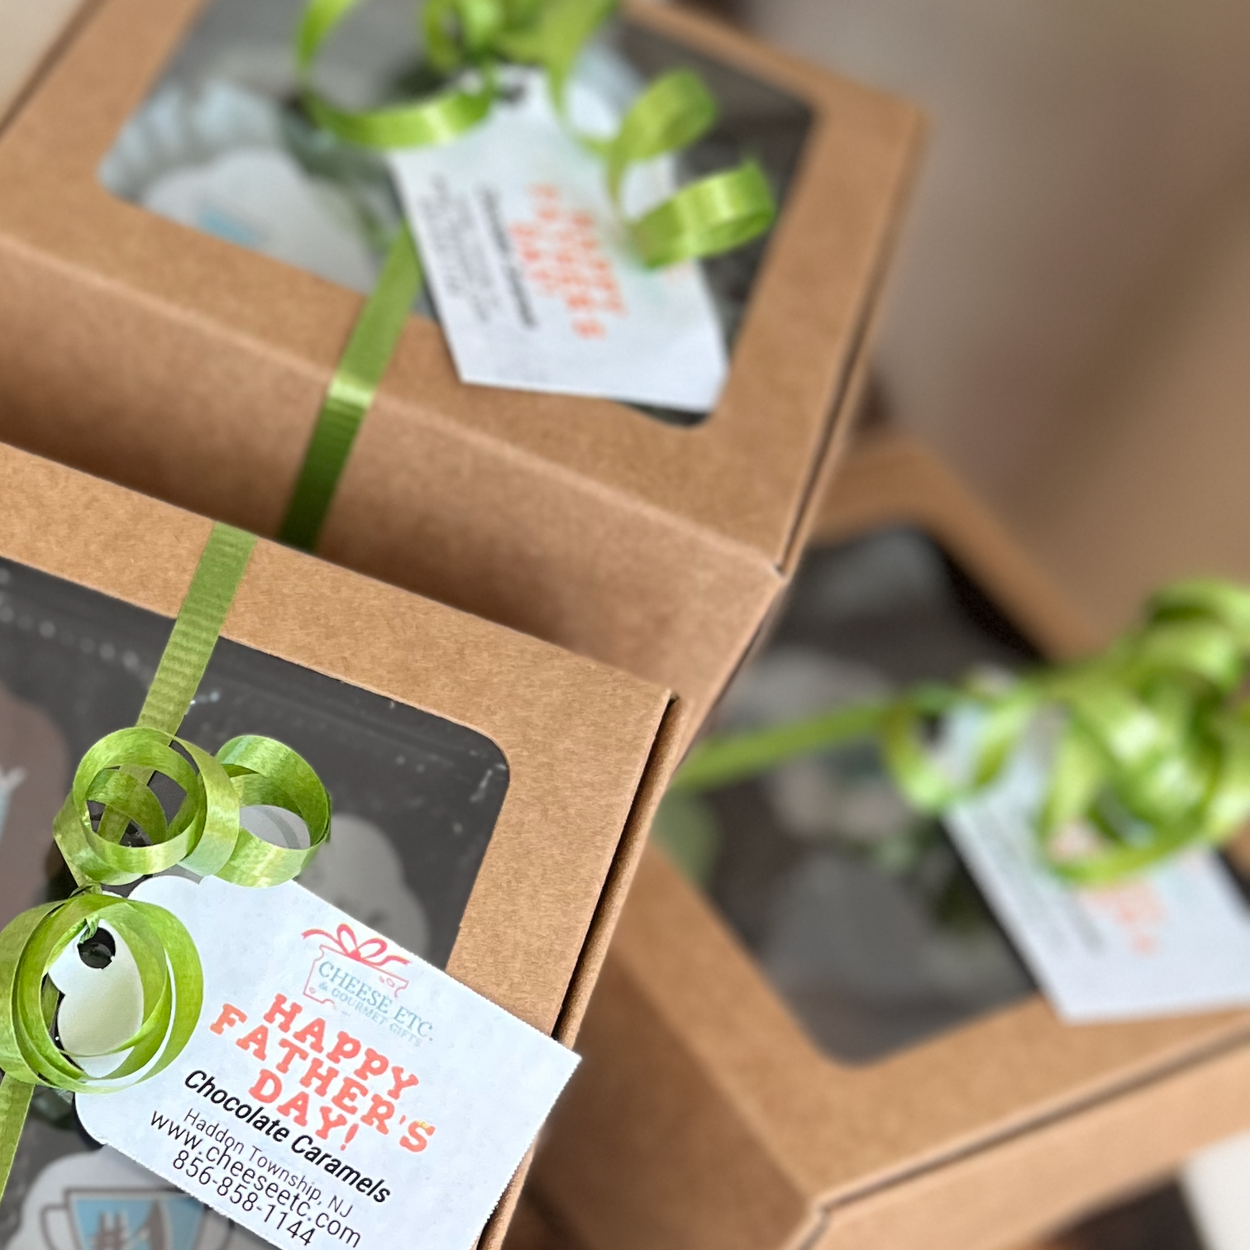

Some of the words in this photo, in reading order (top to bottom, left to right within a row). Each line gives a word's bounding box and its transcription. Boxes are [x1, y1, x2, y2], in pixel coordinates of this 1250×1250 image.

[263, 993, 419, 1100] HAPPY
[318, 960, 393, 1014] CHEESE
[393, 1006, 433, 1042] ETC.
[331, 987, 389, 1026] GOURMET
[389, 1022, 423, 1048] GIFTS
[210, 1003, 436, 1153] FATHER'S
[248, 1068, 359, 1151] DAY!
[150, 1110, 362, 1249] www.cheeseetc.com
[183, 1108, 245, 1155] Haddon
[248, 1145, 323, 1207] Township,
[327, 1195, 354, 1219] NJ
[184, 1069, 290, 1143] Chocolate
[291, 1134, 391, 1204] Caramels
[172, 1150, 316, 1246] 856-858-1144
